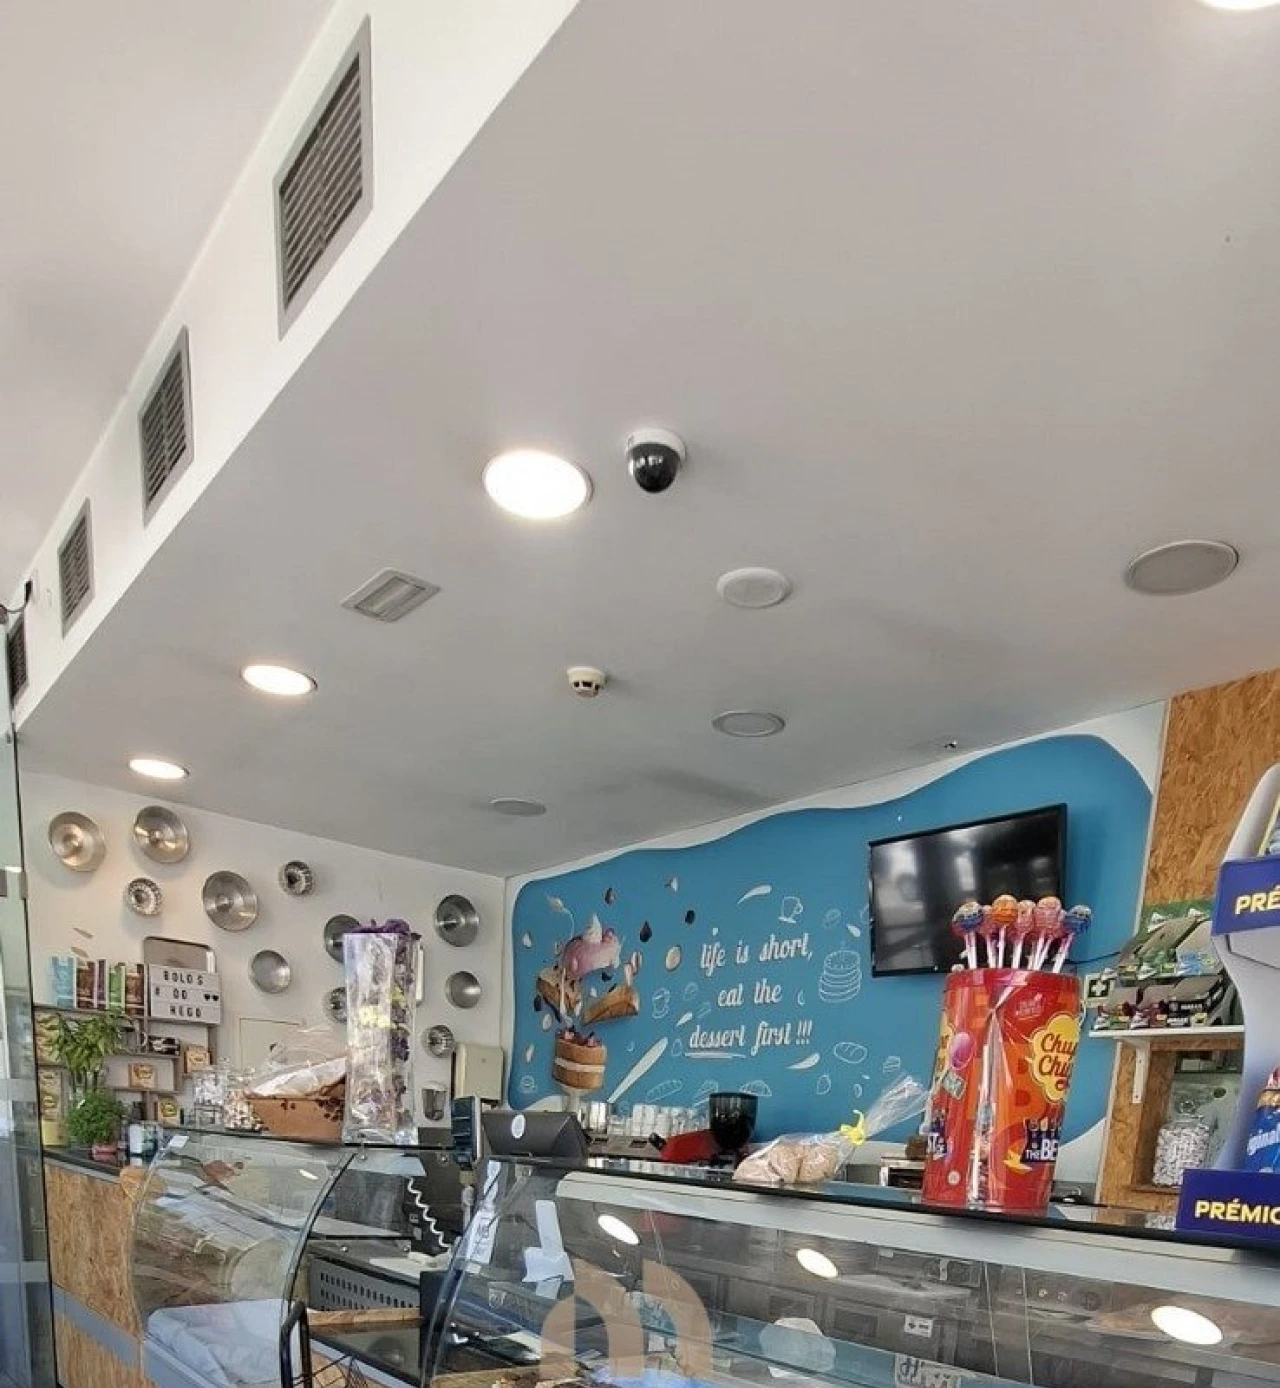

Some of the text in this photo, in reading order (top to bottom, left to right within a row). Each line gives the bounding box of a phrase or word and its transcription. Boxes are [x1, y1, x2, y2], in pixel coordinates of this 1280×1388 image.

[700, 928, 726, 976] life
[736, 940, 749, 965] is
[718, 978, 782, 1007] eat the
[689, 1024, 746, 1049] dessert
